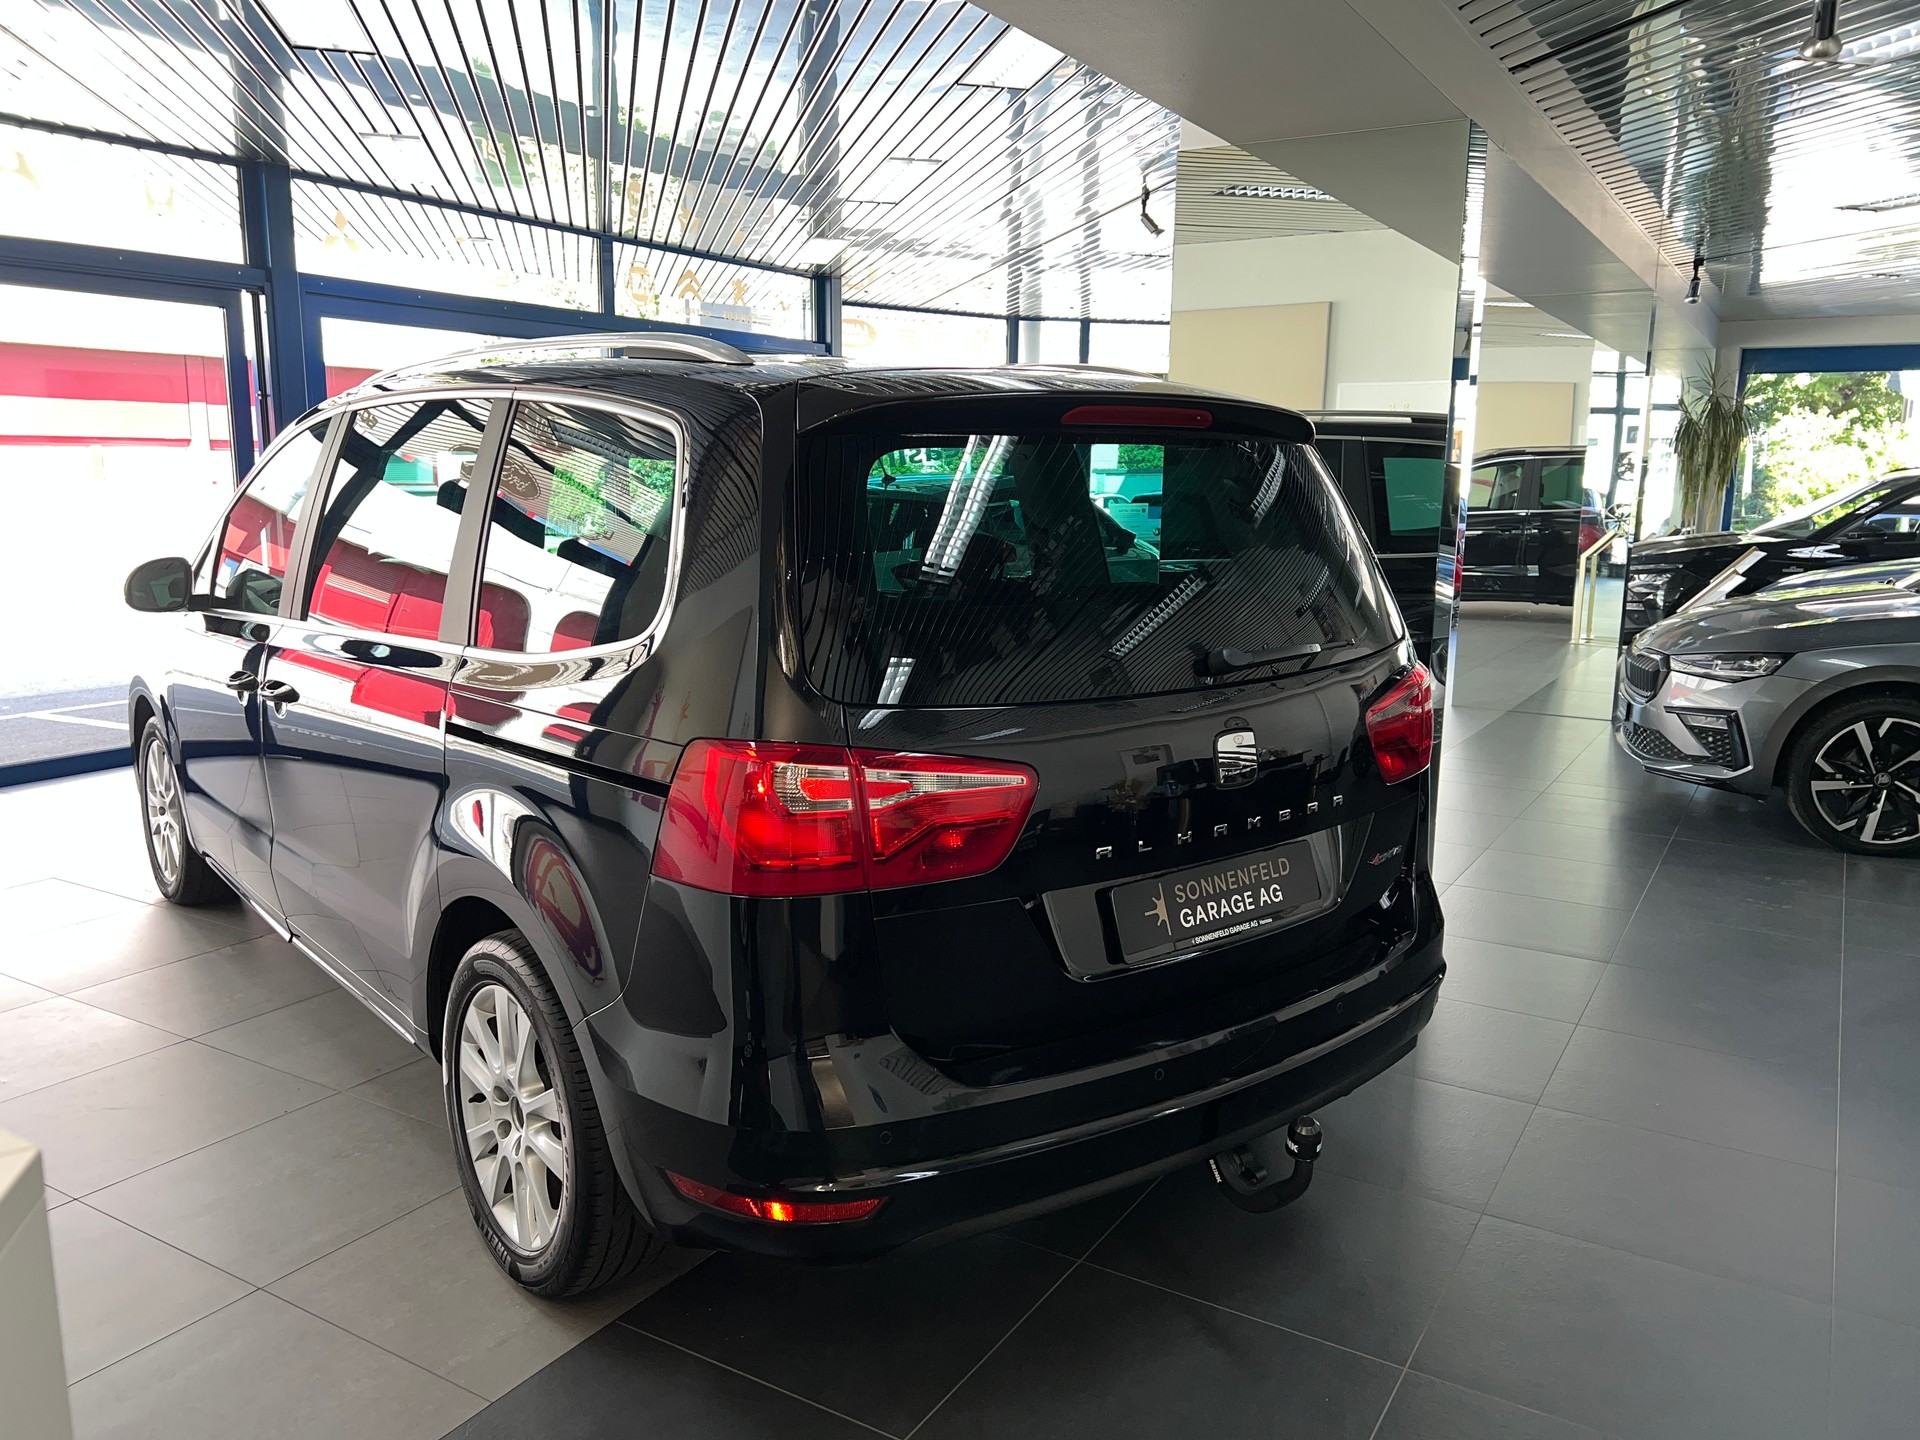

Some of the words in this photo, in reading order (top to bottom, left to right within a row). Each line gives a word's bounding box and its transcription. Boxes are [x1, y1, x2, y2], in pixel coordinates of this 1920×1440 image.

[1095, 794, 1344, 860] ALHAMBRA
[1174, 858, 1290, 903] SONNENFELD
[1180, 891, 1255, 928] GARAGE
[1260, 884, 1283, 906] AG
[1195, 928, 1229, 944] SONNENFELD
[1229, 922, 1251, 934] GARAGE
[1250, 920, 1258, 928] AG
[1209, 1159, 1222, 1183] BRINK
[480, 1219, 511, 1275] PIRELLI
